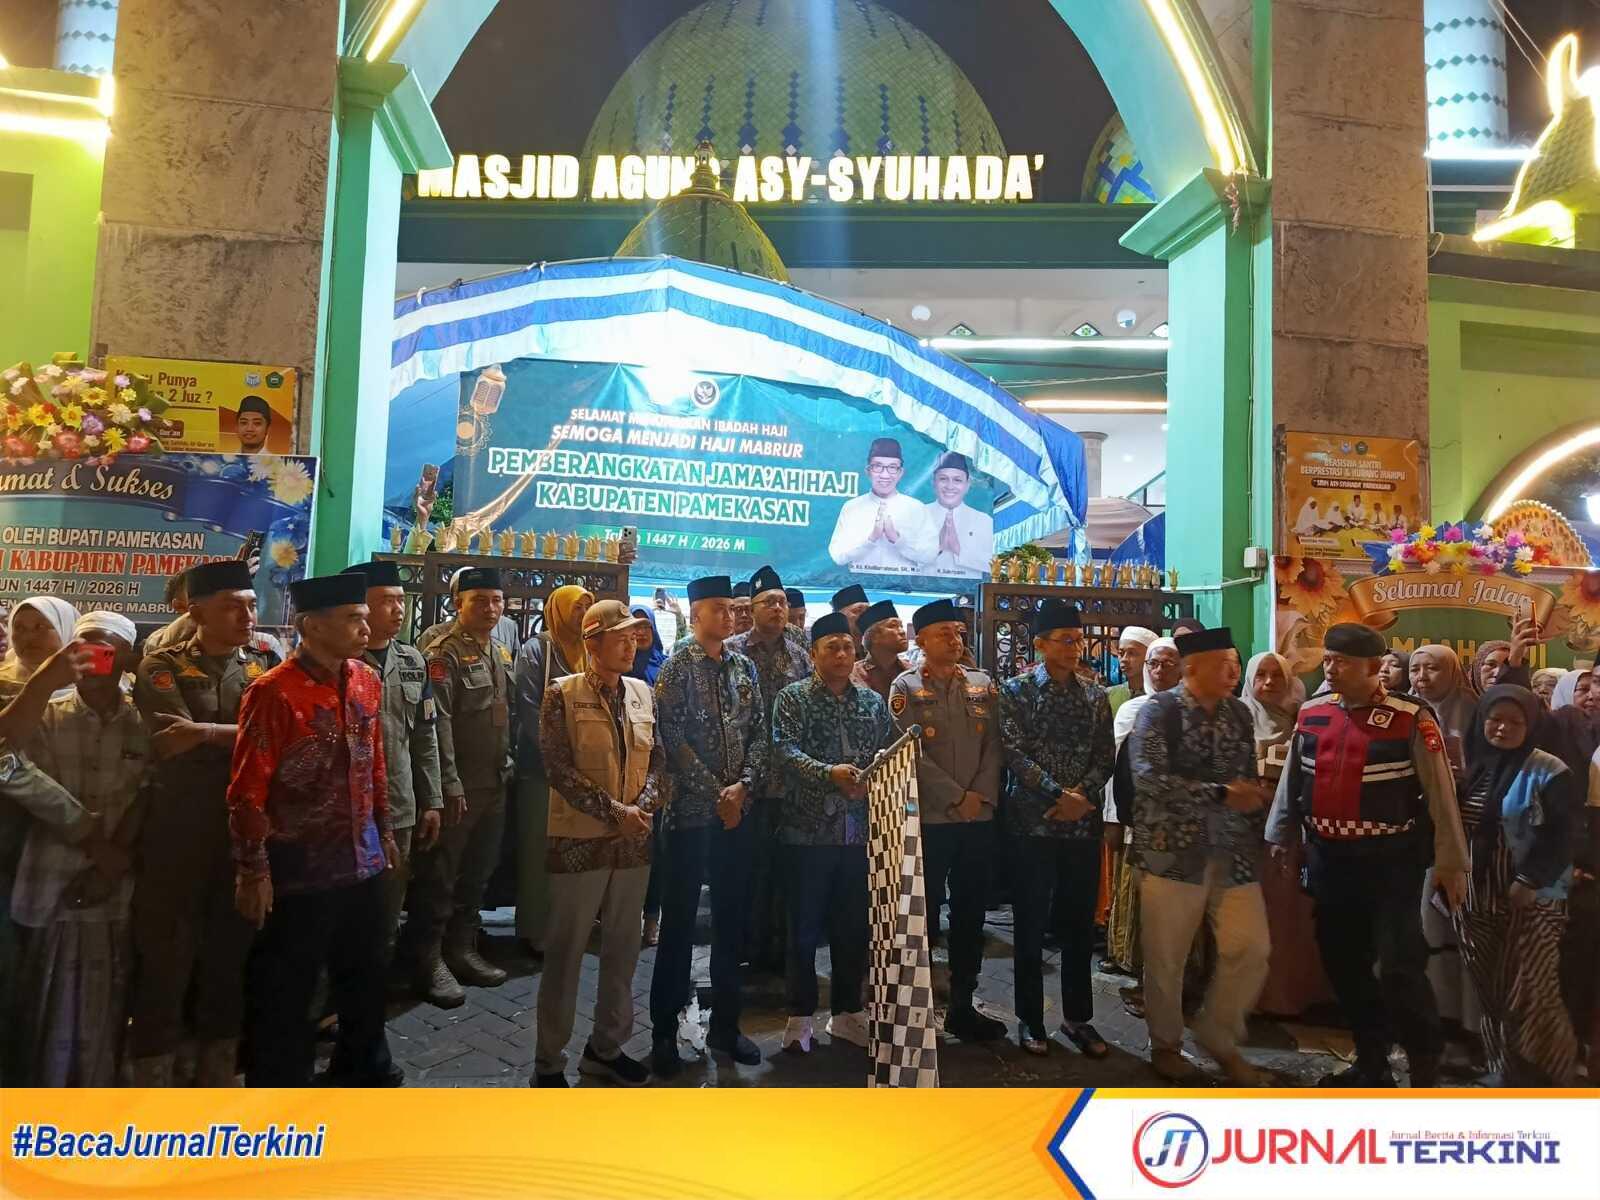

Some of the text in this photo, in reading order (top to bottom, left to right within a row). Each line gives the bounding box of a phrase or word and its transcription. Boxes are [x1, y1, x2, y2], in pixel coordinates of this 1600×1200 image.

[418, 154, 1046, 202] MASJID AGUN ASY-SYUHADA'
[158, 372, 197, 389] Punya
[169, 389, 177, 402] 2
[183, 389, 202, 403] Juz
[206, 391, 214, 404] ?
[570, 408, 626, 424] SELAMAT
[714, 419, 758, 435] IBADAH
[762, 424, 788, 438] HAJI
[551, 425, 804, 459] SEMOGA MENJADI HAJI MABRUR
[90, 464, 173, 500] Sukses
[488, 447, 859, 498] PEMBERANGKATAN JAMA'AH HAJI
[536, 482, 811, 526] KABUPATEN PAMEKASAN
[3, 527, 204, 550] OLEH BUPATI PAMEKASAN
[646, 531, 676, 546] 1447
[678, 535, 689, 548] H
[691, 535, 699, 549] /
[701, 536, 731, 550] 2026
[734, 539, 746, 551] M
[9, 549, 127, 575] KABUPATEN
[24, 578, 60, 593] 1447
[63, 580, 76, 595] H
[77, 580, 86, 595] /
[88, 581, 124, 596] 2026
[127, 581, 141, 596] H
[1372, 579, 1464, 605] Selamat
[86, 602, 123, 612] YANG
[126, 602, 178, 614] MABRU
